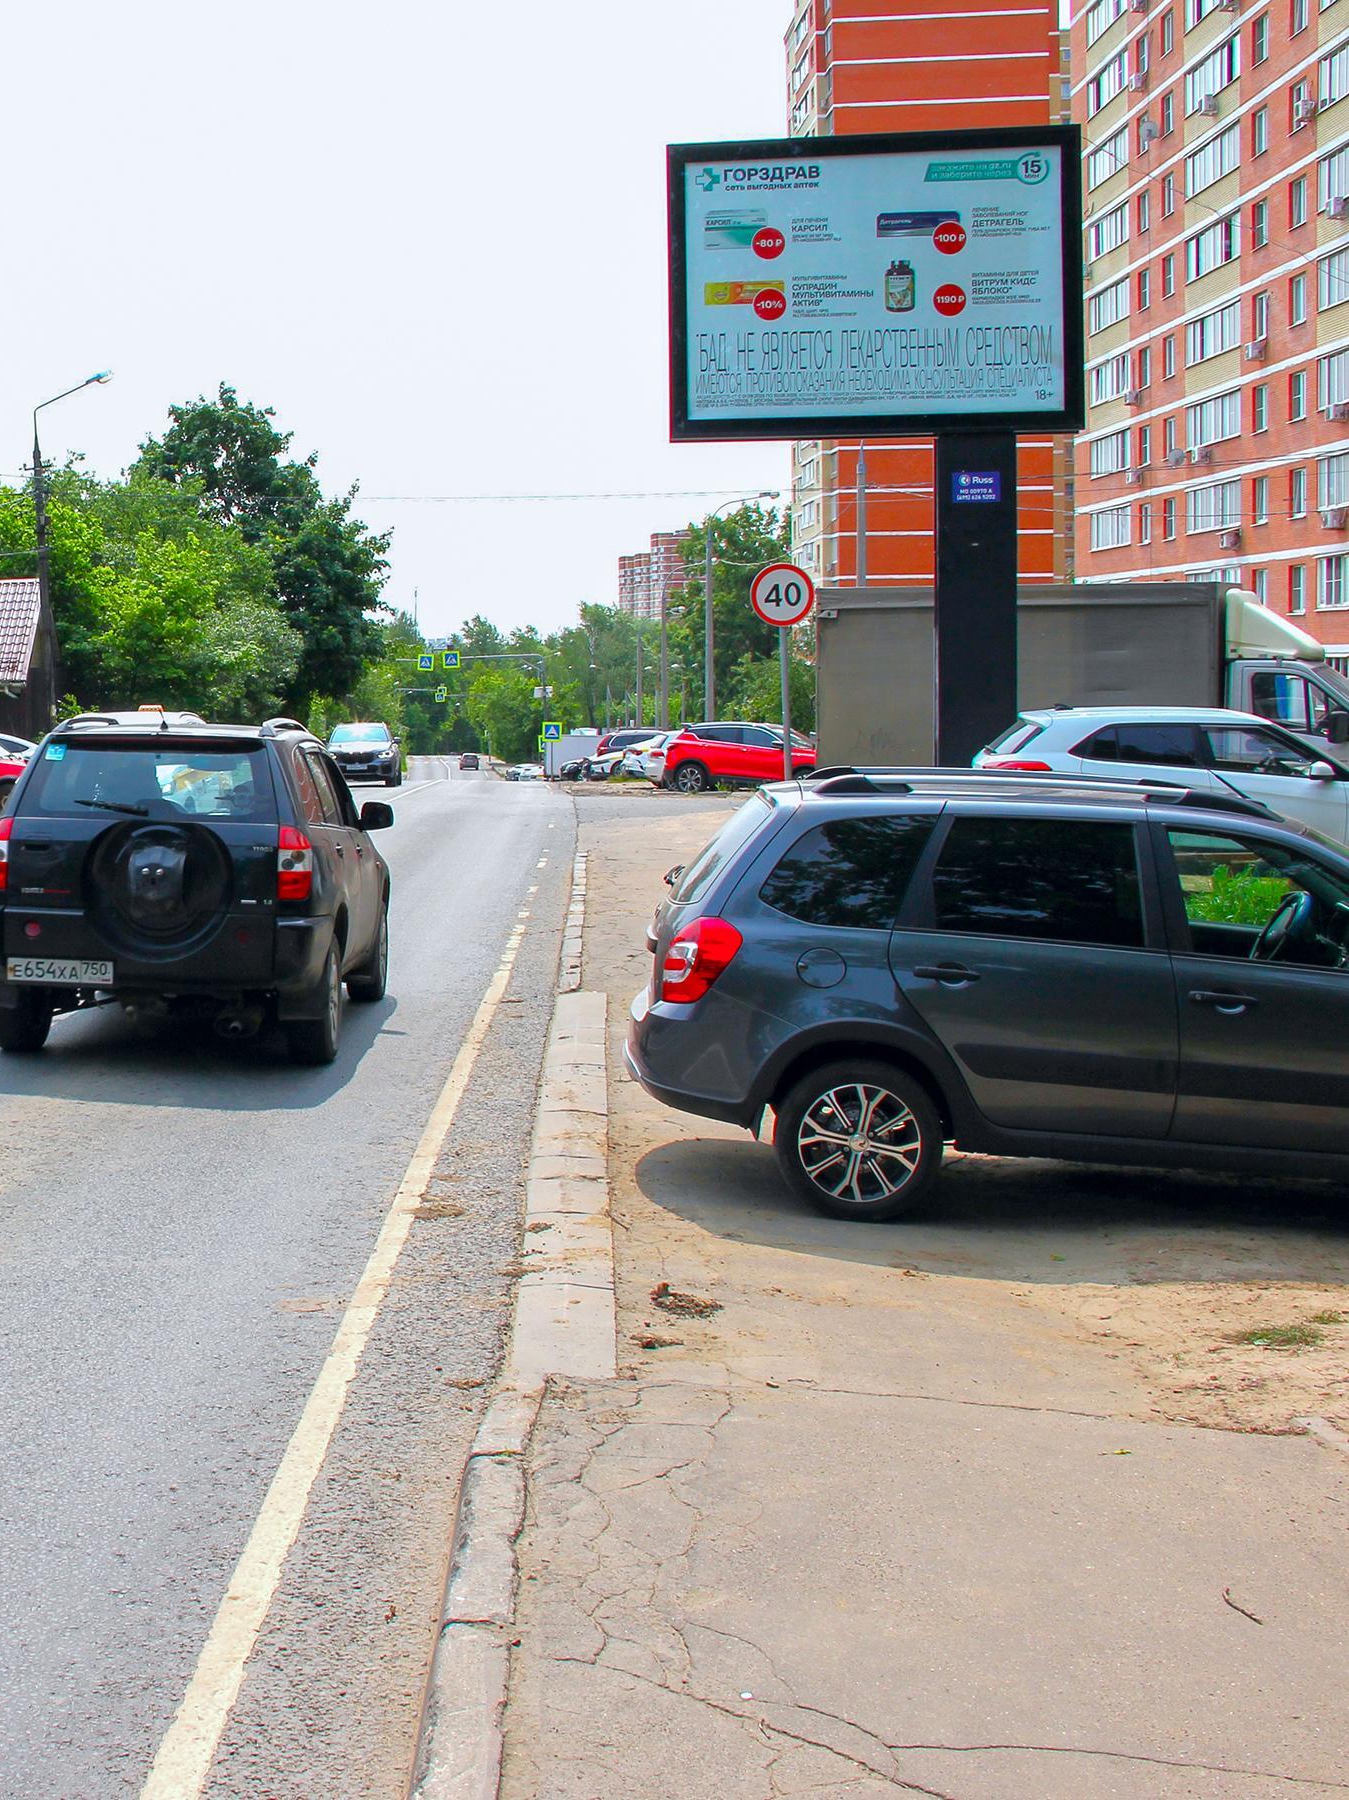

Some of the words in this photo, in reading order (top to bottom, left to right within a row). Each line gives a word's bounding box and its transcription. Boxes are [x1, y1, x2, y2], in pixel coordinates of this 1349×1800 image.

[1021, 160, 1041, 174] 15
[723, 165, 820, 182] ГОРЗДРАВ
[725, 184, 745, 192] сеть
[747, 183, 792, 191] выгодных
[794, 181, 820, 189] аптек
[791, 224, 828, 232] КАРСИЛ
[971, 218, 1024, 228] ДЕТРАГЕЛЬ
[934, 234, 957, 242] -100
[755, 239, 774, 248] -80
[792, 283, 837, 291] СУПРАДИН
[971, 278, 1008, 287] ВИТРУМ
[1010, 277, 1036, 286] КИДС
[792, 290, 874, 299] МУЛЬТИВИТАМИНЫ
[936, 295, 957, 304] 1190
[756, 300, 783, 309] -10%
[736, 331, 755, 371] НЕ
[761, 329, 833, 371] ЯВЛЯЕТСЯ
[839, 327, 960, 369] ЛЕКАРСТВЕННЫМ
[965, 325, 1053, 367] СРЕДСТВОМ
[695, 373, 742, 394] ИМЕЮТСЯ
[745, 371, 845, 393] ПРОТИВОПОКАЗАНИЯ
[848, 369, 911, 391] НЕОБХОДИМА
[914, 367, 984, 390] КОНСУЛЬТАЦИЯ
[986, 366, 1053, 388] СПЕЦИАЛИСТА
[1034, 389, 1054, 400] 18+
[972, 476, 994, 484] Russ
[764, 581, 802, 607] 40
[81, 961, 108, 976] 750
